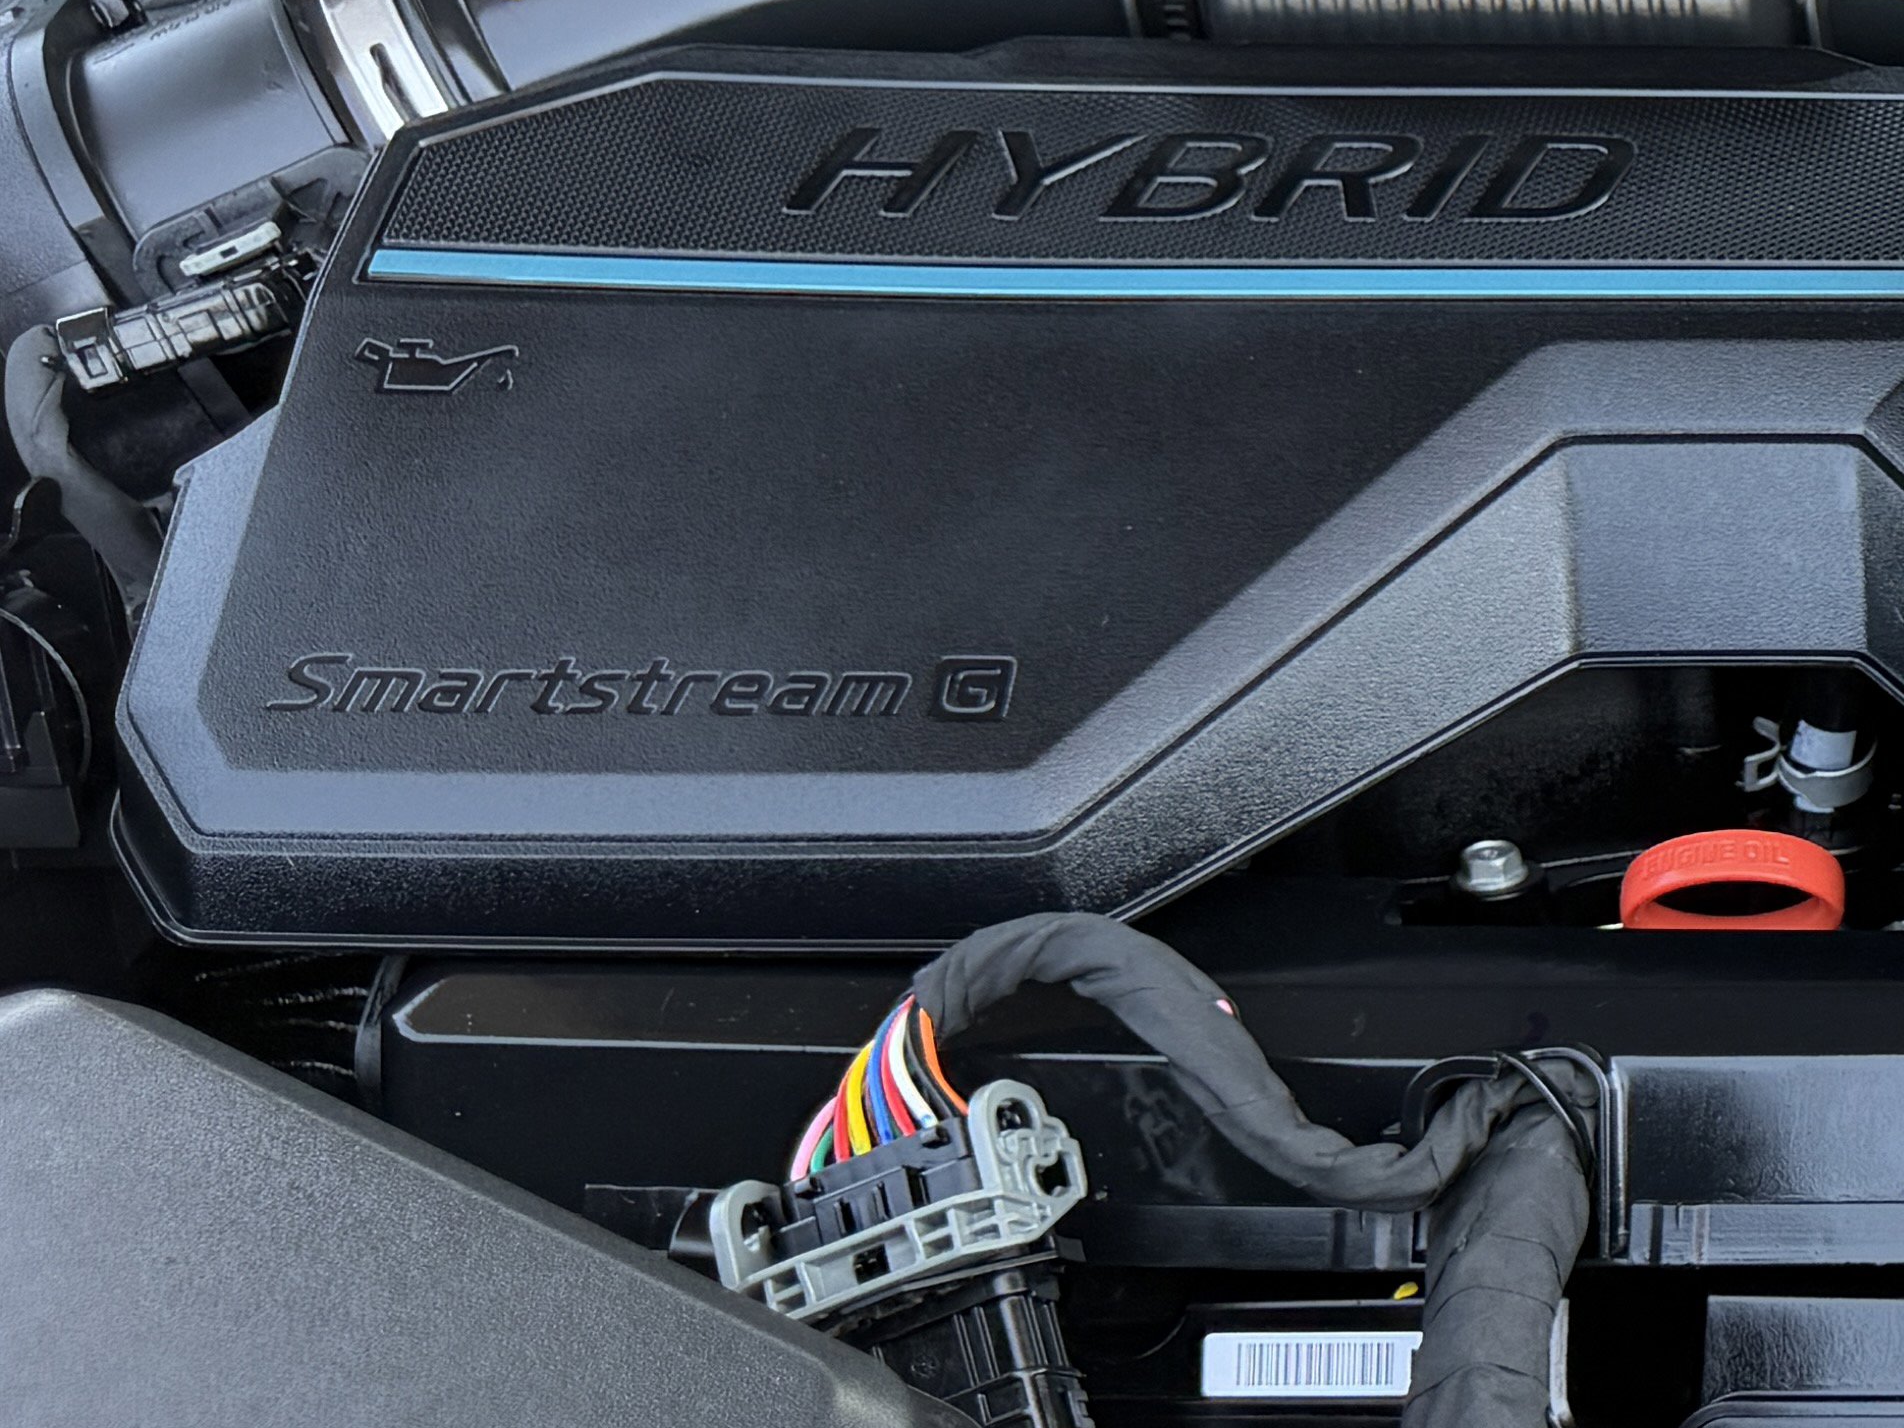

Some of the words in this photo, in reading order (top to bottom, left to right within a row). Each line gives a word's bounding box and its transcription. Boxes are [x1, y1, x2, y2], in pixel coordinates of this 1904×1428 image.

[782, 125, 1640, 224] HYBRID
[265, 652, 912, 718] Smartstream
[1641, 839, 1737, 879] ENGINE
[1744, 839, 1790, 867] OIL
